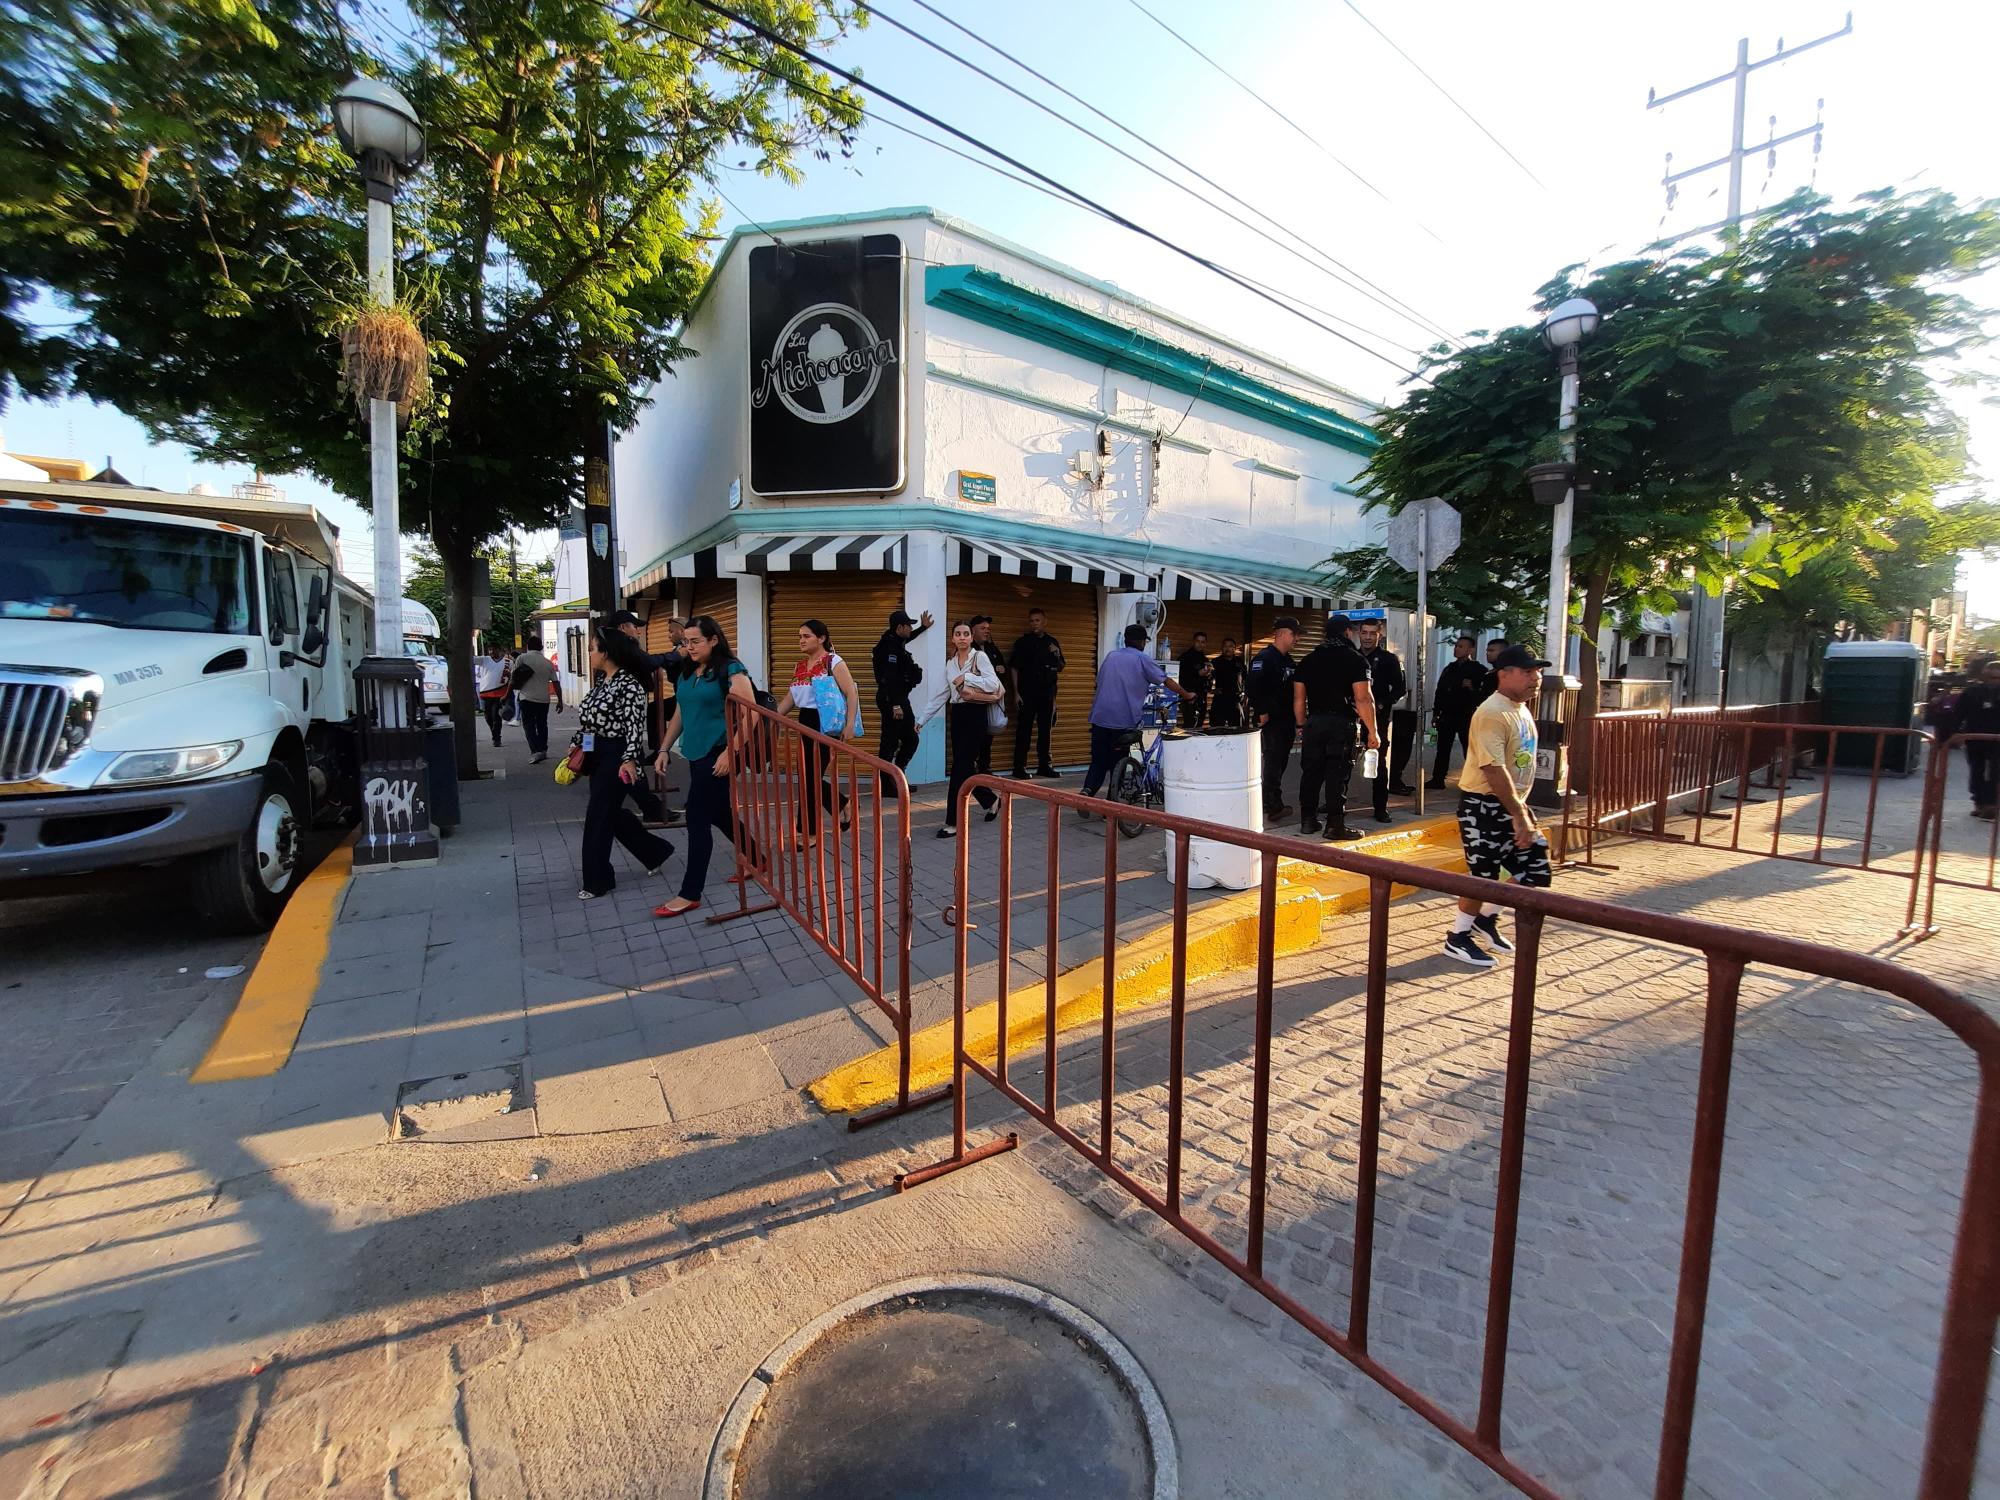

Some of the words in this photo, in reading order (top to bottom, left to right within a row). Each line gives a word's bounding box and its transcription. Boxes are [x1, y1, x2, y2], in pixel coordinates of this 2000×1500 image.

[788, 332, 807, 348] La
[752, 338, 898, 408] Michoacana
[136, 663, 164, 680] 3575
